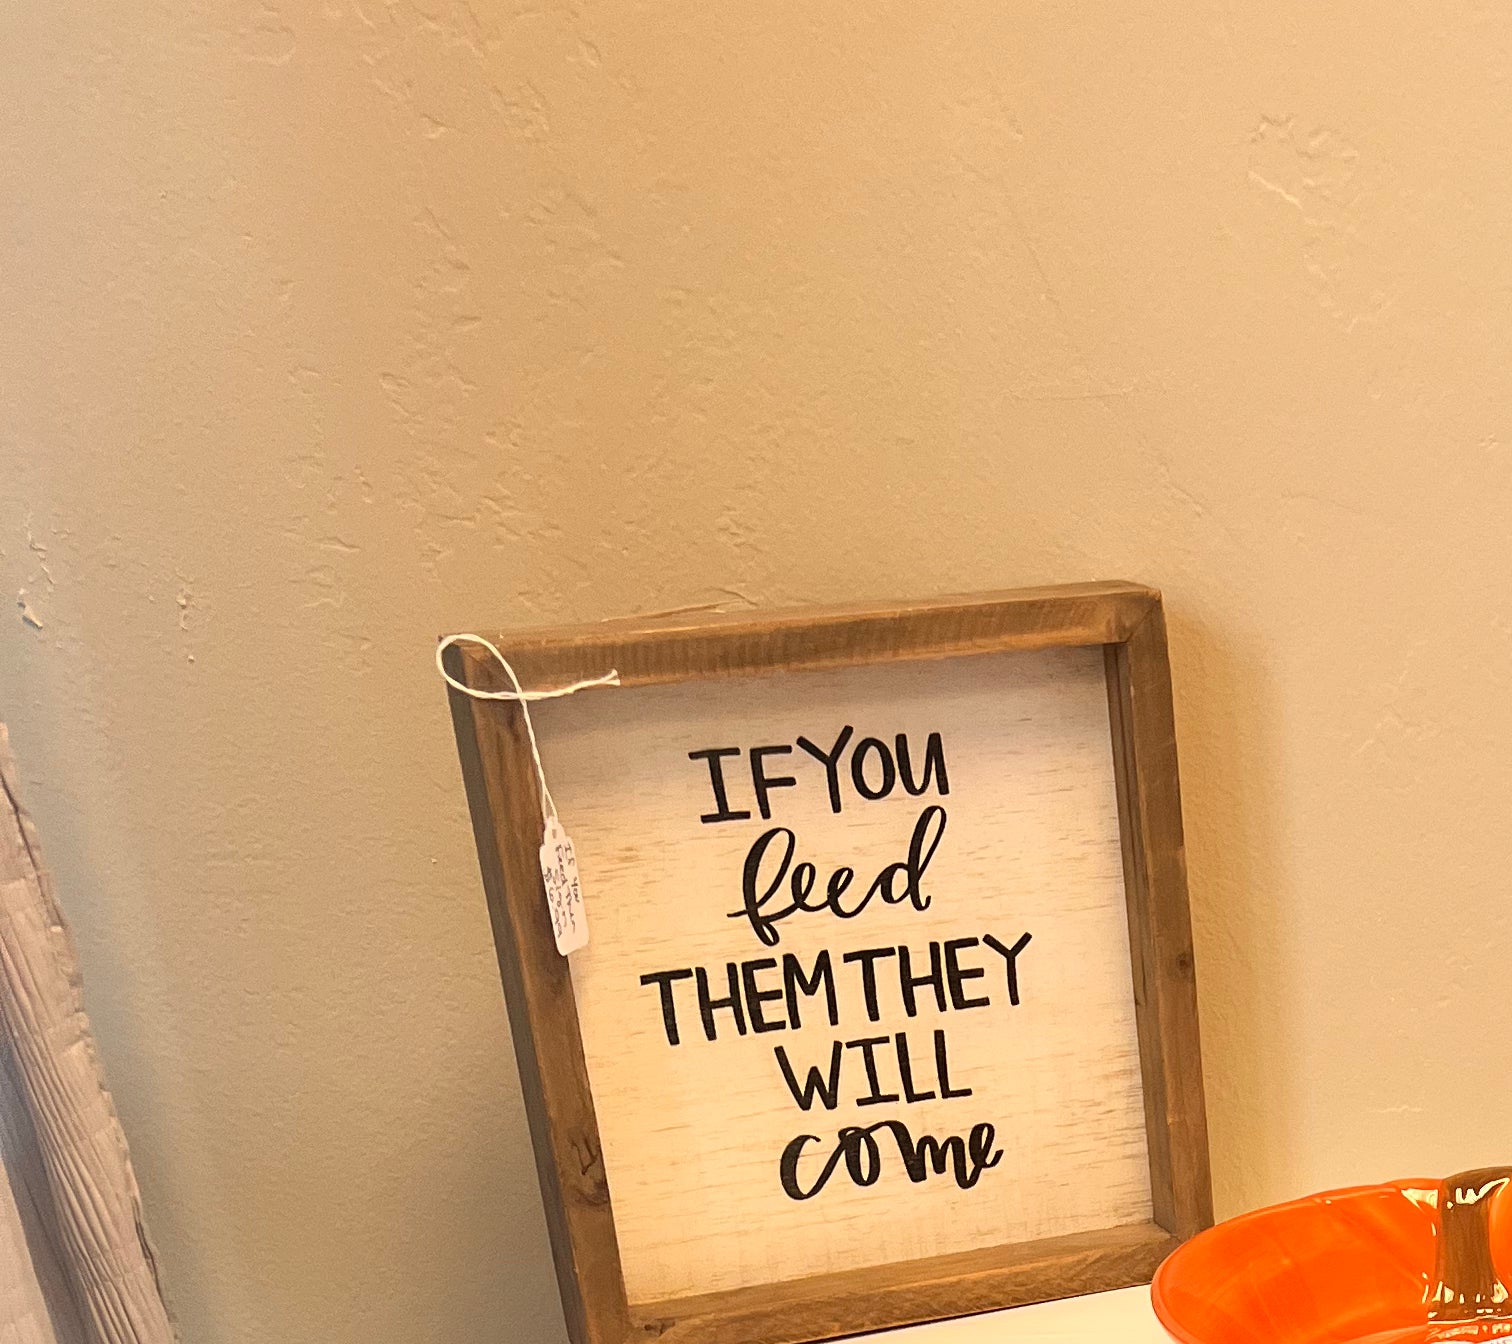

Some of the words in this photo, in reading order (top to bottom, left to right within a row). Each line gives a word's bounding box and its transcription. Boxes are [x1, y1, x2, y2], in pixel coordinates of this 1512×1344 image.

[727, 805, 947, 946] feed
[640, 950, 839, 1047] THEM
[843, 932, 1033, 1023] THEY
[774, 1029, 973, 1111] WILL
[780, 1119, 1004, 1201] come
